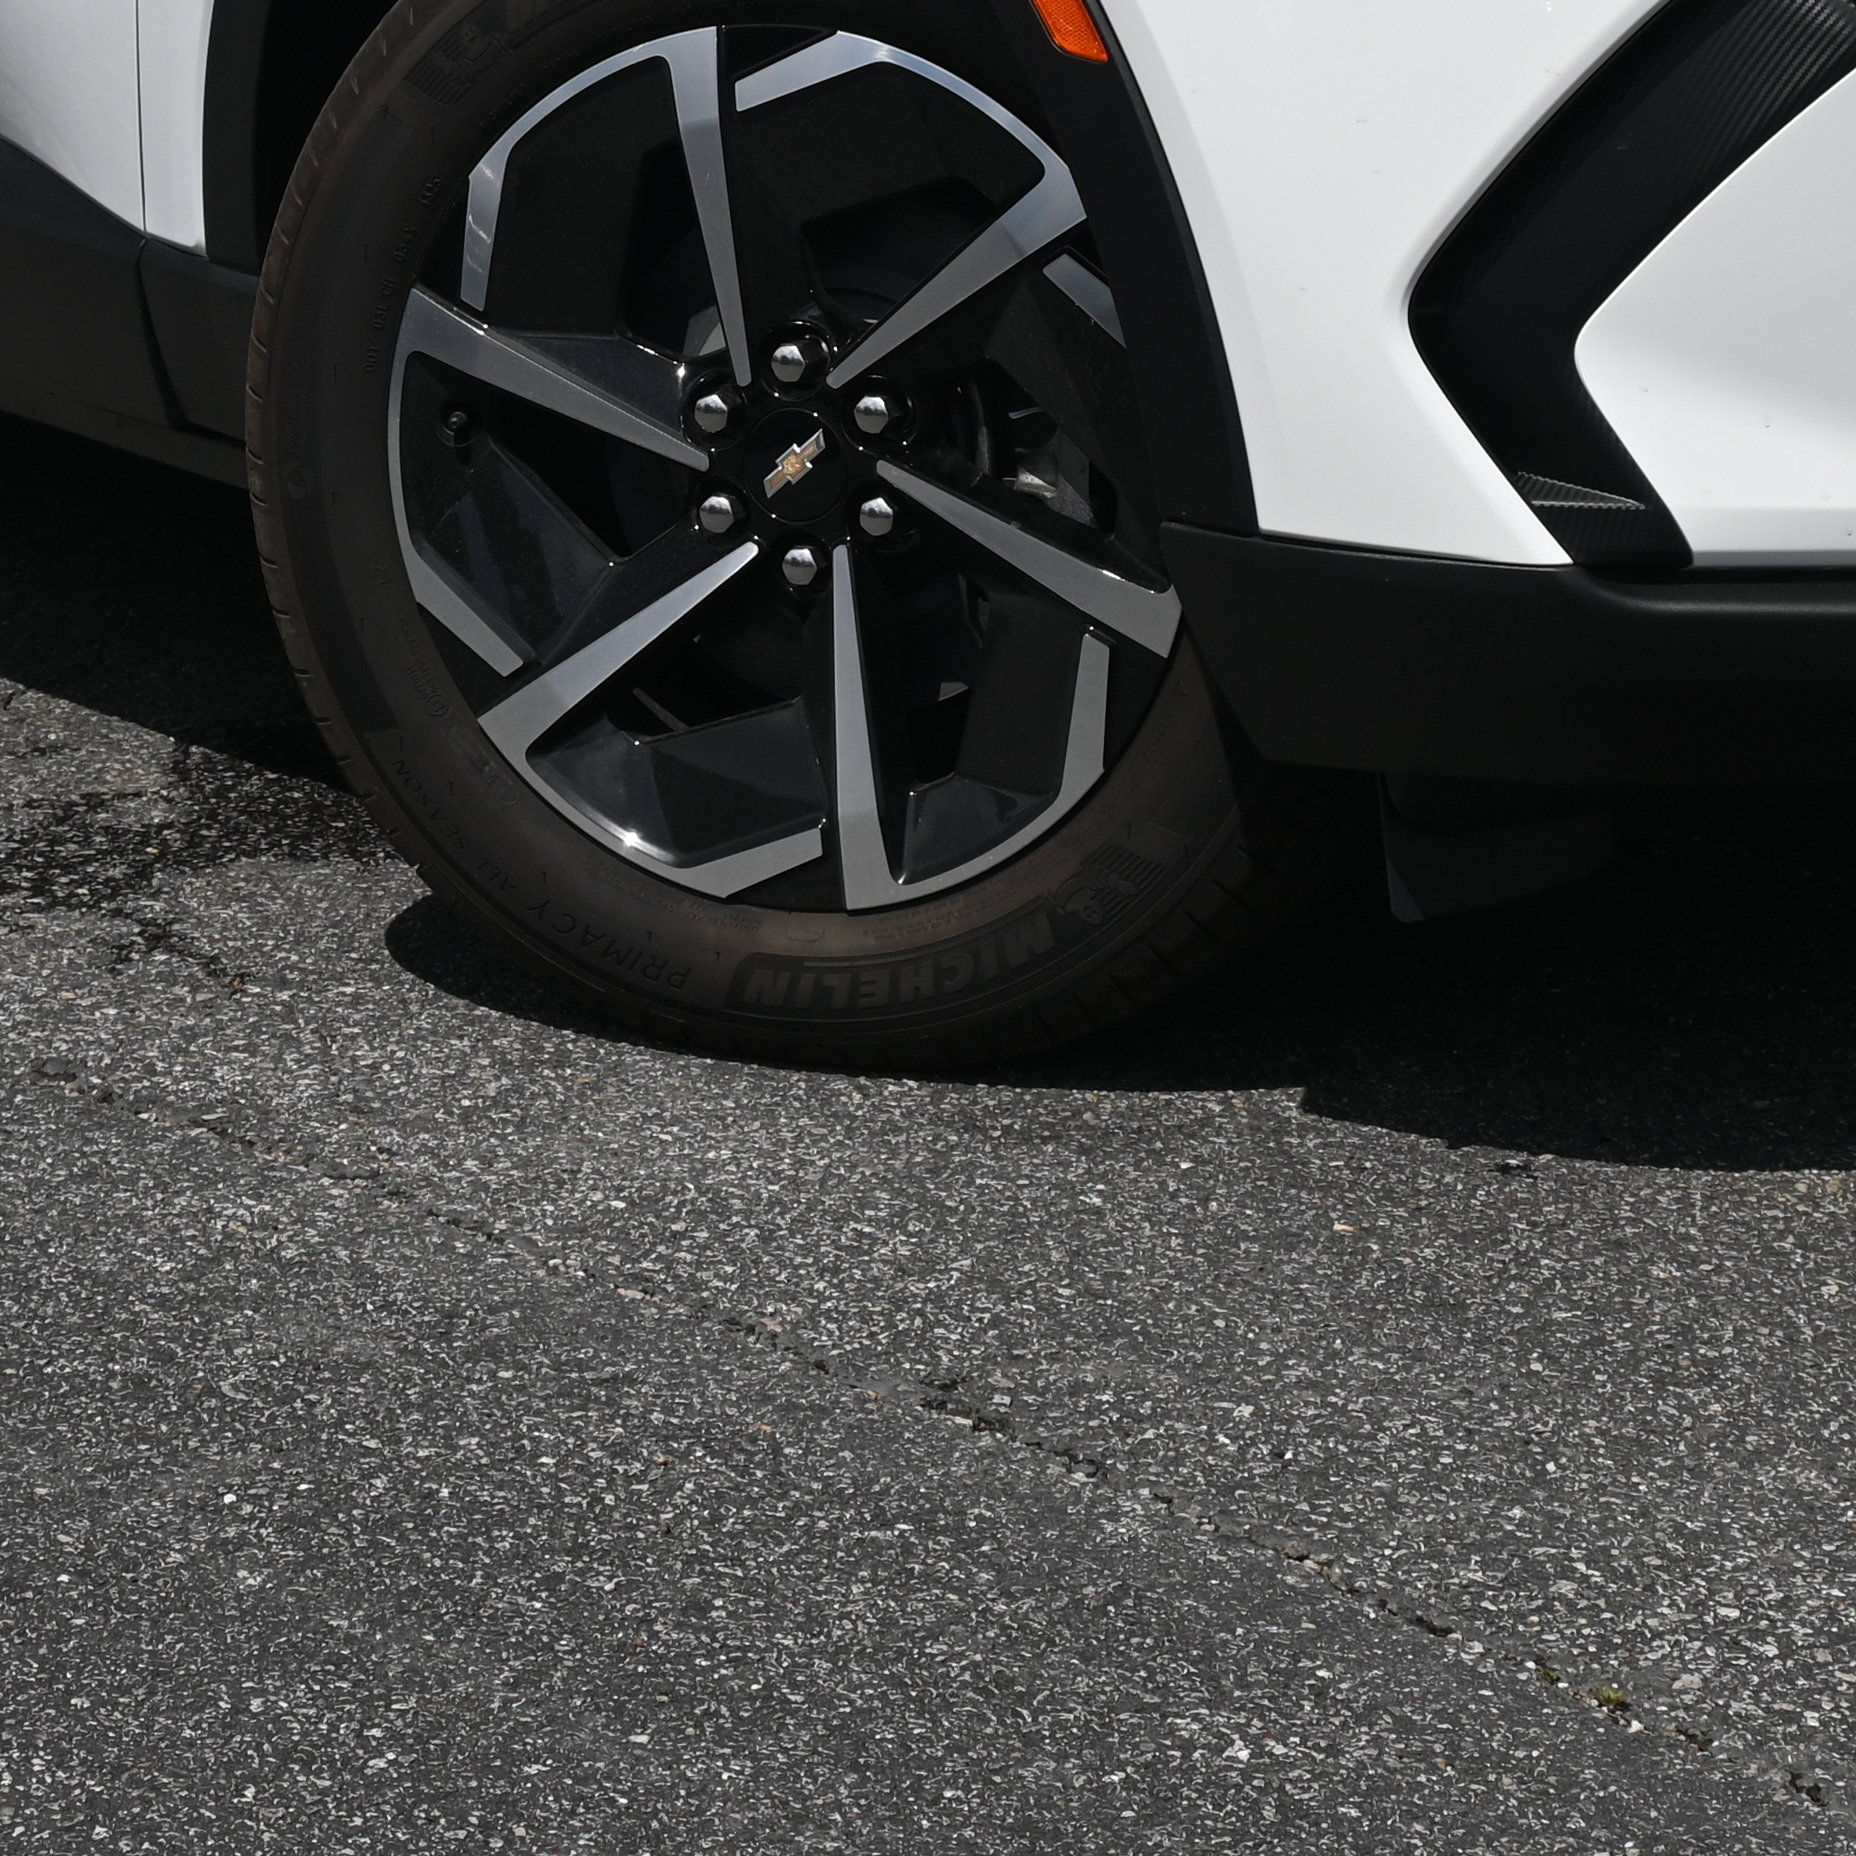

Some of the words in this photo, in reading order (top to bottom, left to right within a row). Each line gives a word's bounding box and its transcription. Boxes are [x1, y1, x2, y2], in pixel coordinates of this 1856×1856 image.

[390, 758, 472, 852] SEASON
[478, 860, 518, 893] ALL
[526, 897, 694, 992] PRIMACY
[743, 910, 1058, 1012] MICHELIN
